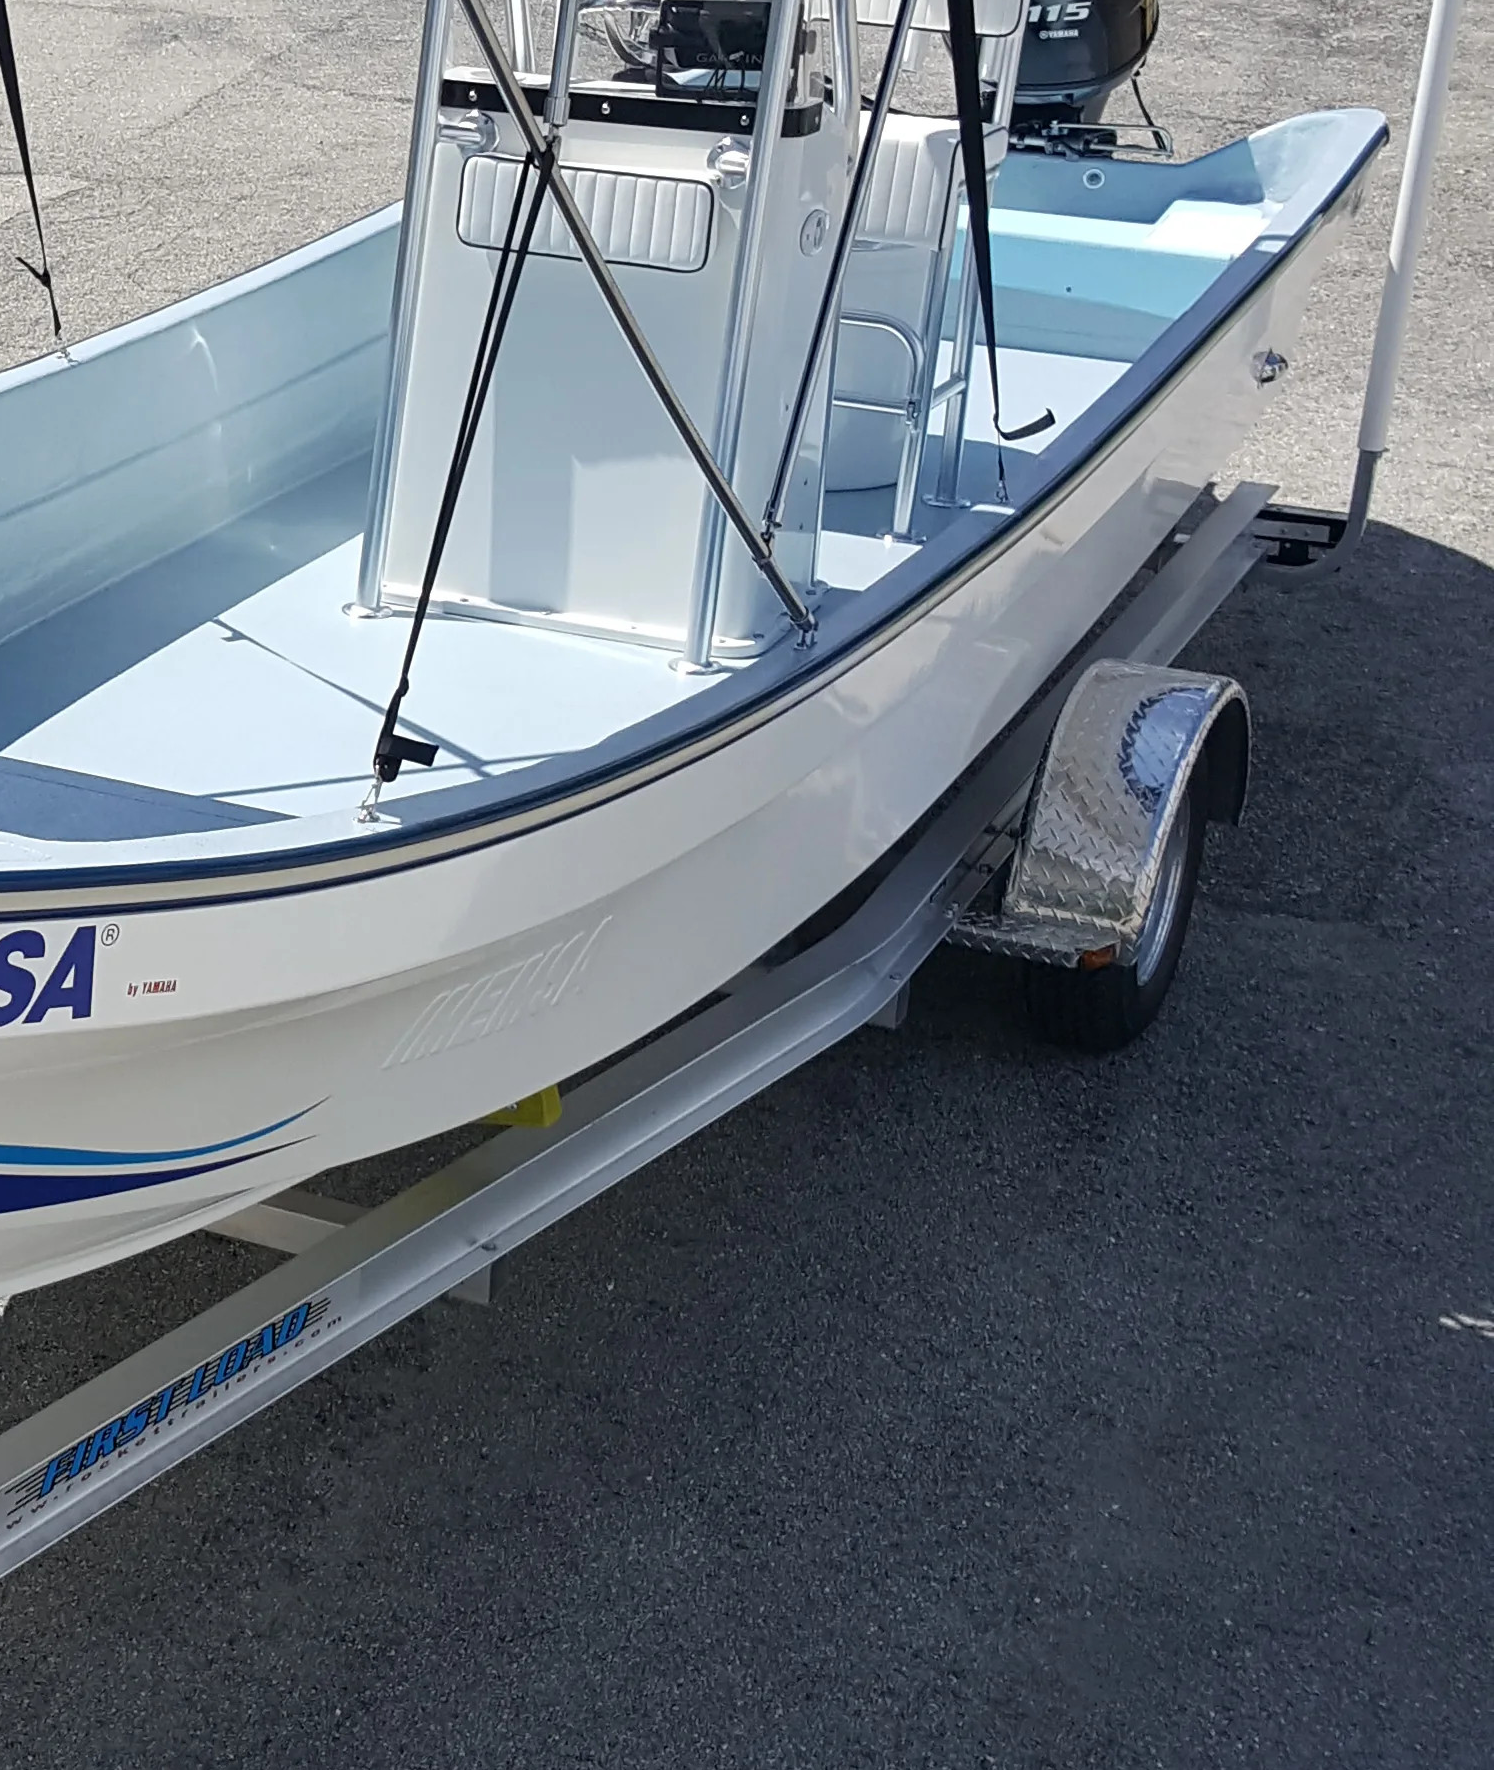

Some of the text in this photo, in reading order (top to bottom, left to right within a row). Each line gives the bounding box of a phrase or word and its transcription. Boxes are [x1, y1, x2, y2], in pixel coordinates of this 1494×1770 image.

[1028, 1, 1092, 22] 115
[1048, 29, 1079, 39] YAMAHA
[696, 52, 763, 64] GAIN
[127, 979, 177, 998] by YAMAHA
[38, 1301, 313, 1501] FIRST LOAD
